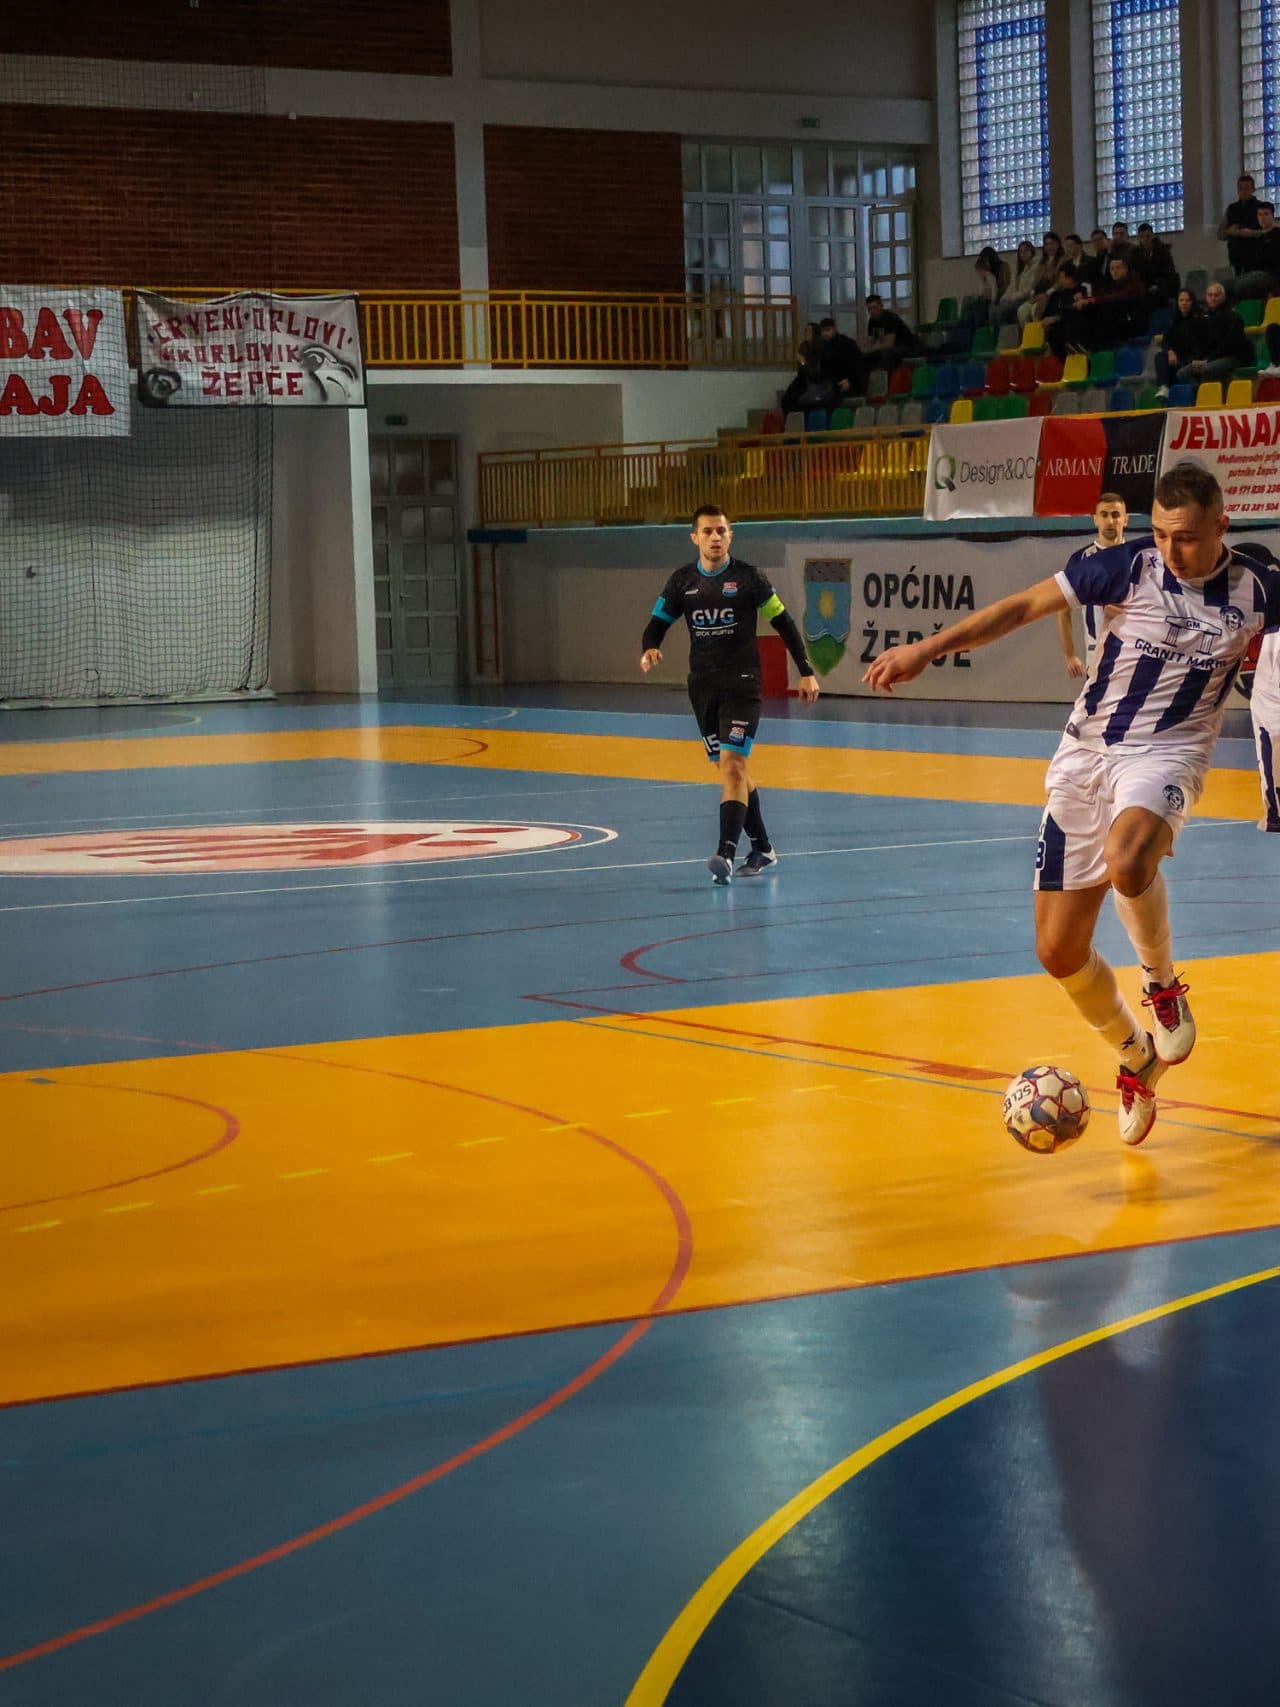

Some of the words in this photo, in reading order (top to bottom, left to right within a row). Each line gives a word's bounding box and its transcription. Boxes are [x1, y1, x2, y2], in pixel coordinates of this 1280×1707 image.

[252, 307, 346, 349] ORLOVI
[201, 365, 304, 397] ŽEPČE
[1112, 455, 1155, 475] TRADE
[863, 566, 975, 610] OPĆINA
[692, 608, 734, 626] GVG
[1135, 639, 1184, 662] GRANIT
